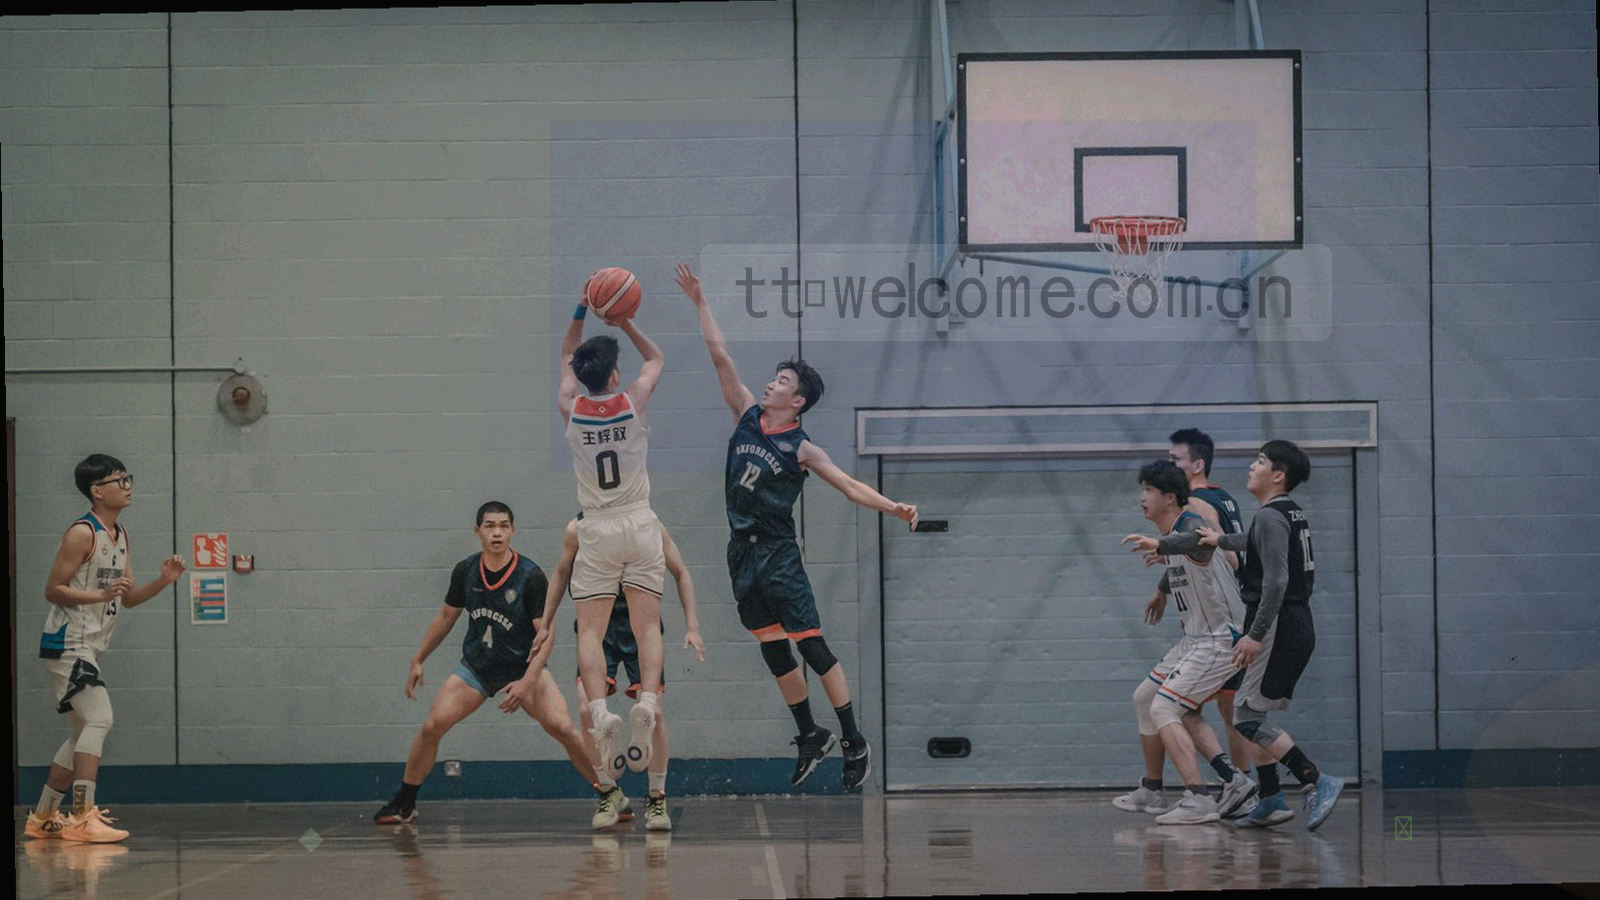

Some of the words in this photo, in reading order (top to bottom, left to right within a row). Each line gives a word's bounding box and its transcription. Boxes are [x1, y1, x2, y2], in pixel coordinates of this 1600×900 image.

[595, 450, 621, 490] 0
[736, 444, 783, 475] OXFORDCSSA
[740, 461, 762, 491] 12
[1174, 591, 1188, 612] 11
[482, 624, 493, 649] 4
